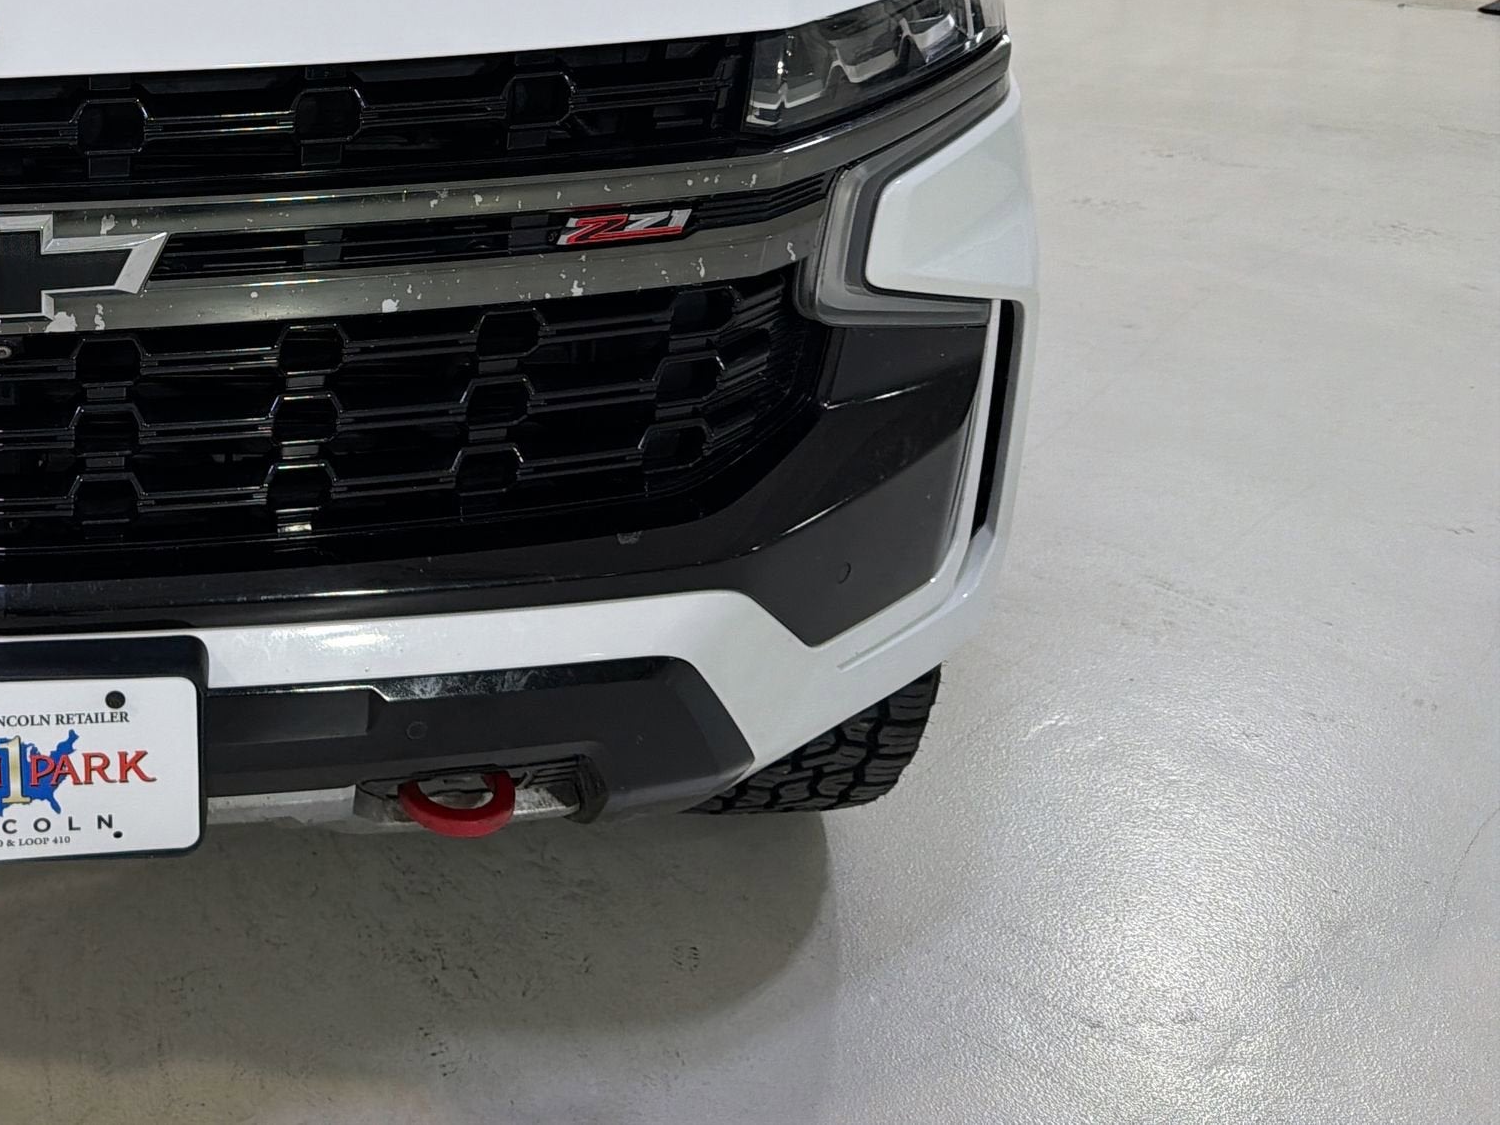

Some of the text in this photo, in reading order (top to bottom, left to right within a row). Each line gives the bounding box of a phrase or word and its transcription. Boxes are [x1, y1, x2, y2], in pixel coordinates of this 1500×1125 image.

[557, 208, 692, 245] Z71
[55, 711, 130, 725] RETAILER
[29, 750, 157, 787] PARK
[6, 839, 16, 847] &
[18, 838, 50, 846] LOOP
[52, 835, 71, 845] 410
